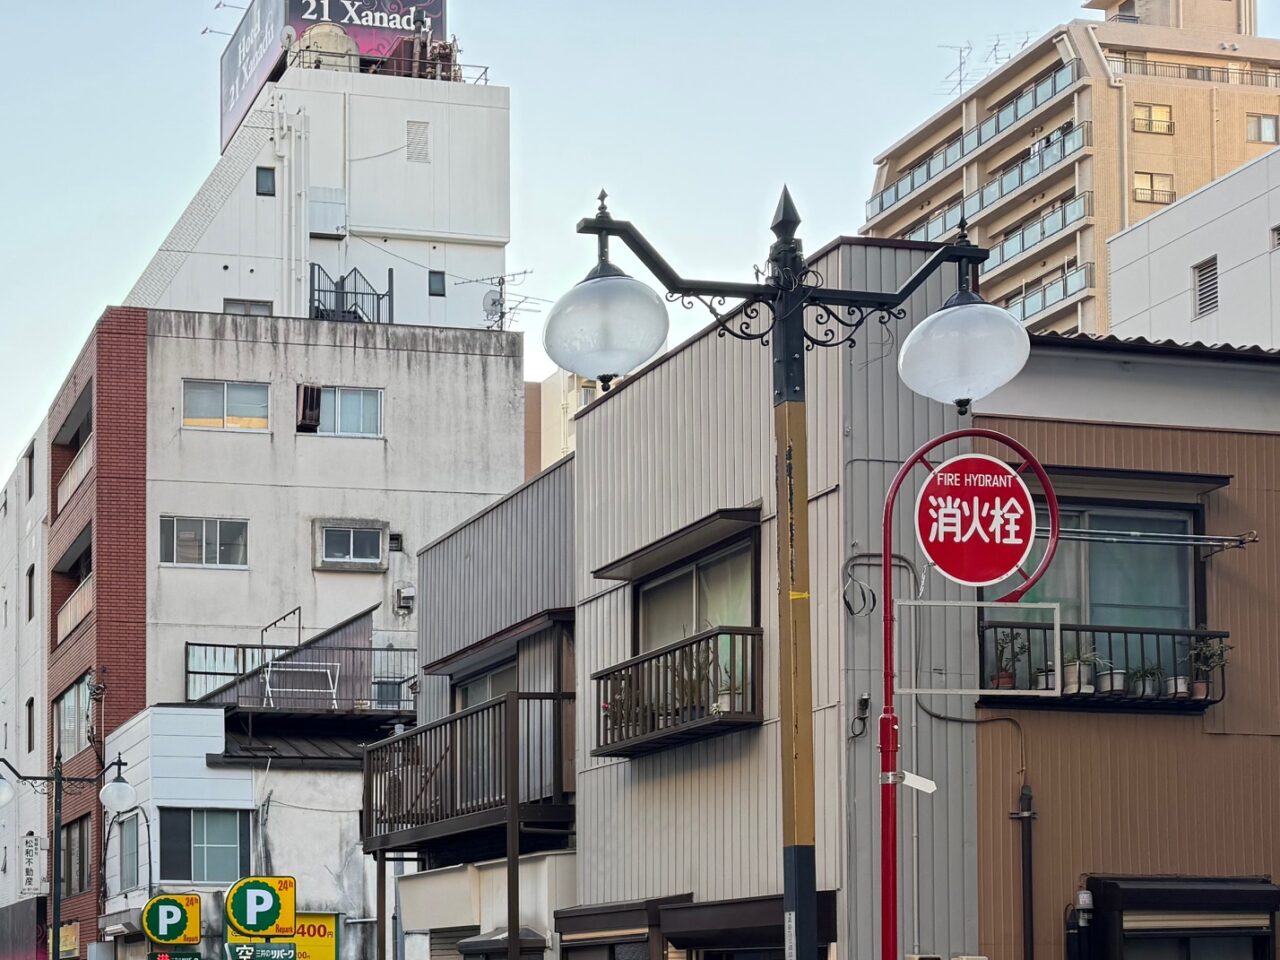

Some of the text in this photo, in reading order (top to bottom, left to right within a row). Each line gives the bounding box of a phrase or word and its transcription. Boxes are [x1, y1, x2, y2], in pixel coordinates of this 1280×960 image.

[301, 0, 332, 22] 21
[937, 473, 1014, 488] FIRE HYDRANT
[928, 495, 1024, 545] 消火栓
[246, 888, 274, 925] P
[158, 904, 182, 935] P
[275, 924, 294, 934] Repark
[256, 949, 294, 959] 三井のリパーク
[296, 951, 310, 959] 00円
